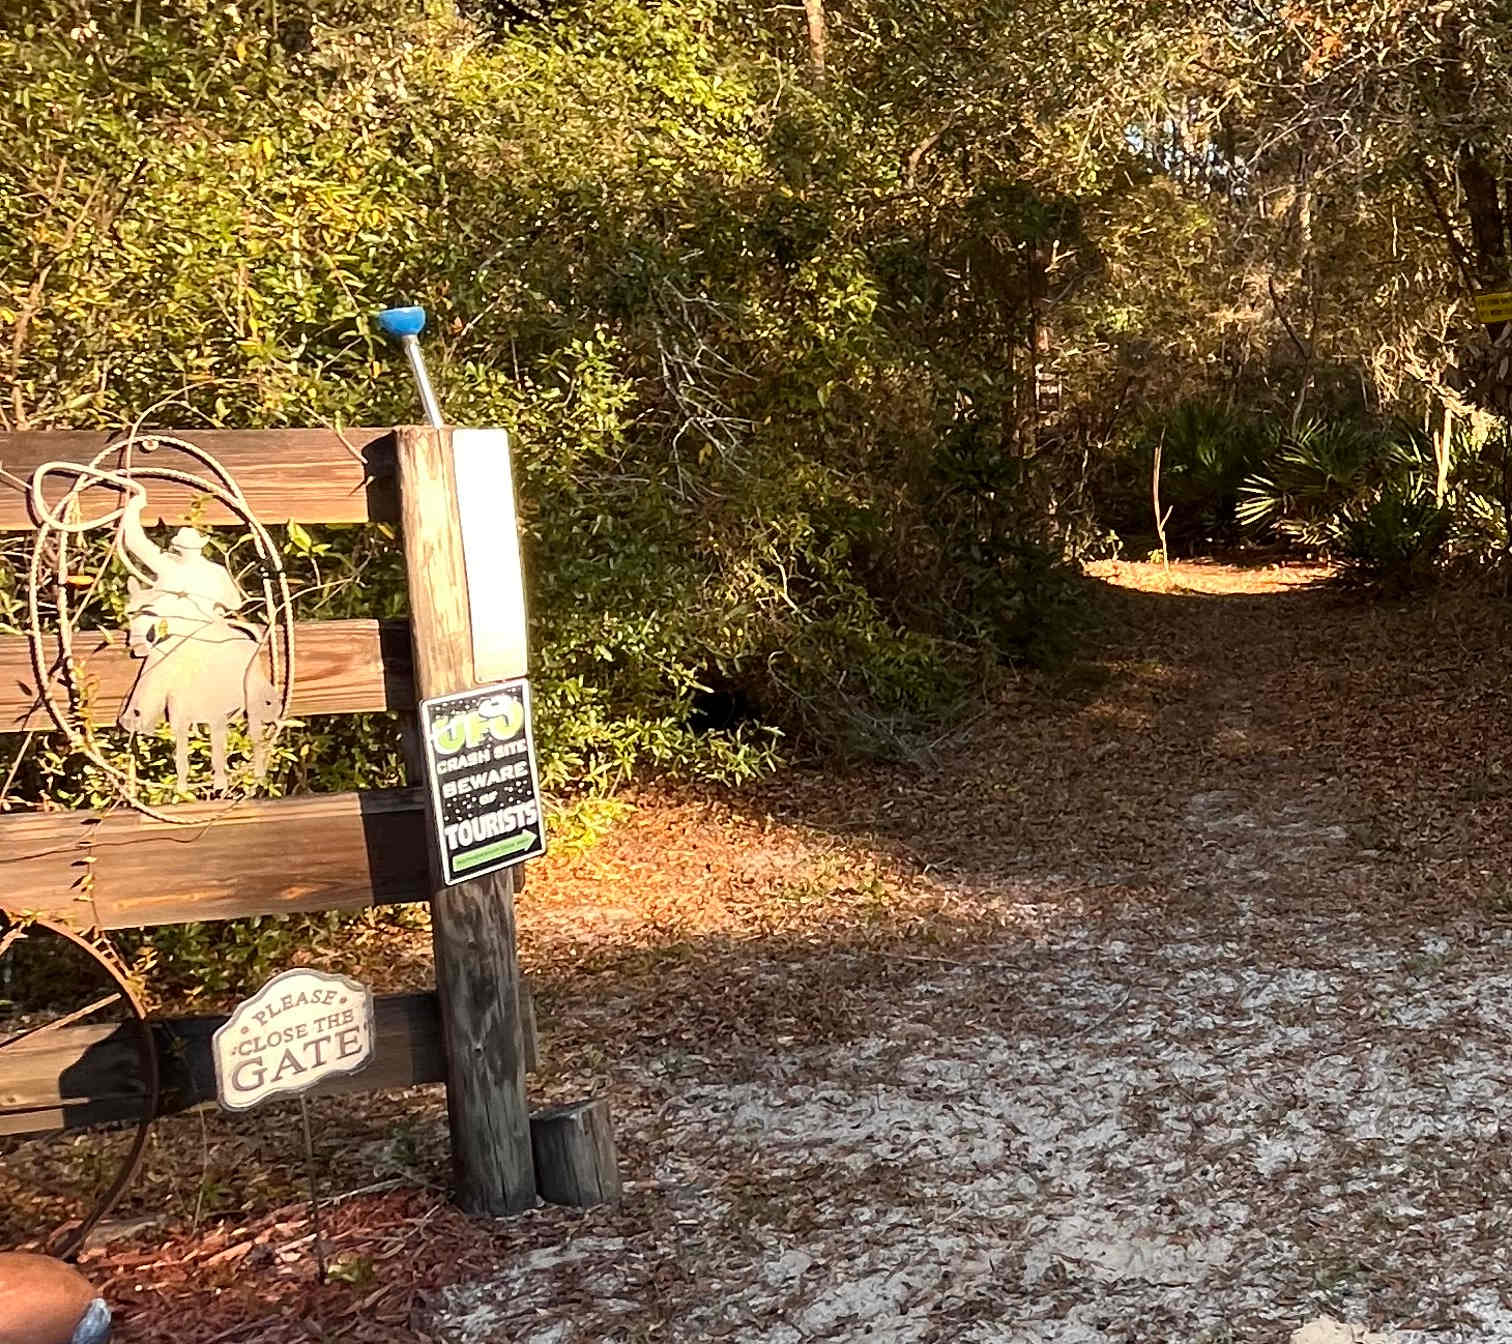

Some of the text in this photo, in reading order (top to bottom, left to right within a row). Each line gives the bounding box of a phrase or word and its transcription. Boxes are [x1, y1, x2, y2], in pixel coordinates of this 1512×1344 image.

[431, 693, 525, 755] UFO
[436, 738, 528, 775] CRASH SITE
[441, 760, 529, 799] BEWARE
[444, 799, 538, 850] TOURISTS
[251, 989, 337, 1027] PLEASE
[238, 1009, 355, 1056] CLOSE THE
[231, 1025, 363, 1092] GATE
